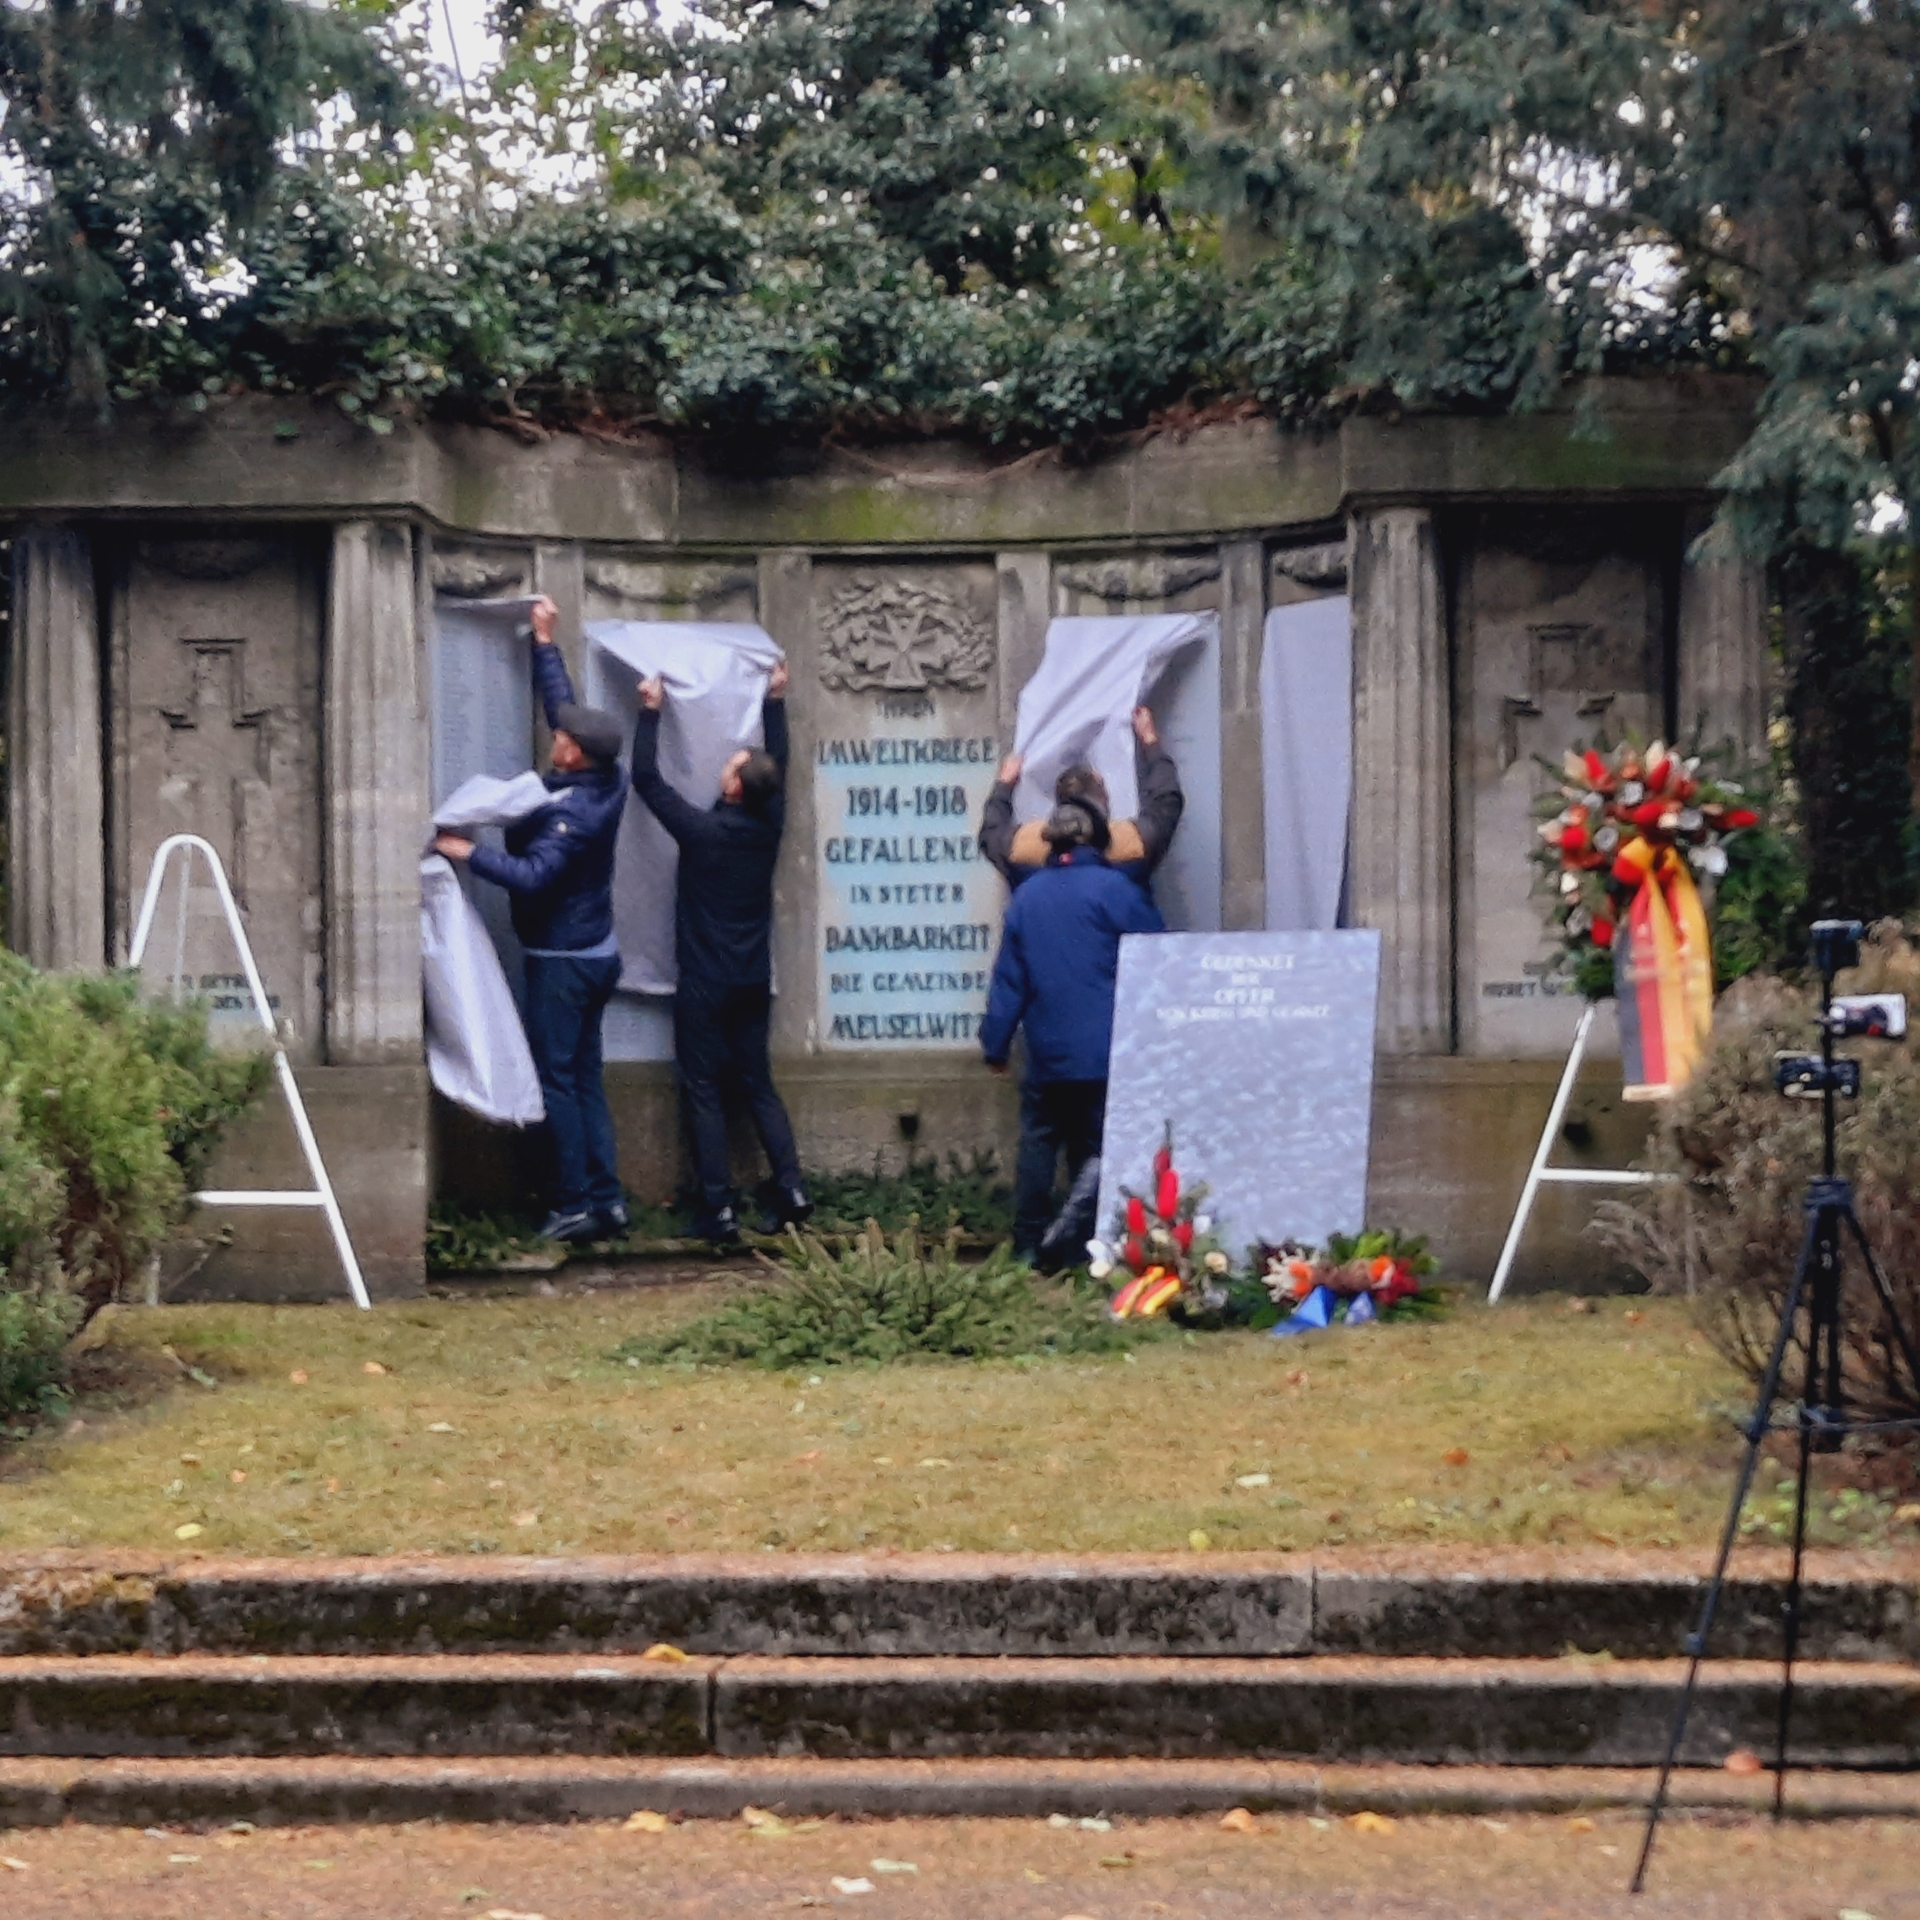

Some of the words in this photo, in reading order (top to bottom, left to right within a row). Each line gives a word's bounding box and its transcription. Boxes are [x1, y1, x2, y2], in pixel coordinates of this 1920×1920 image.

[847, 785, 968, 816] 1914-1918
[825, 835, 981, 863] GEFALLENE
[850, 883, 872, 904] IN
[879, 883, 965, 904] STETER
[825, 924, 990, 953] DANKBARKEIT
[830, 972, 862, 993] DIE
[872, 971, 986, 992] GEMEINDE
